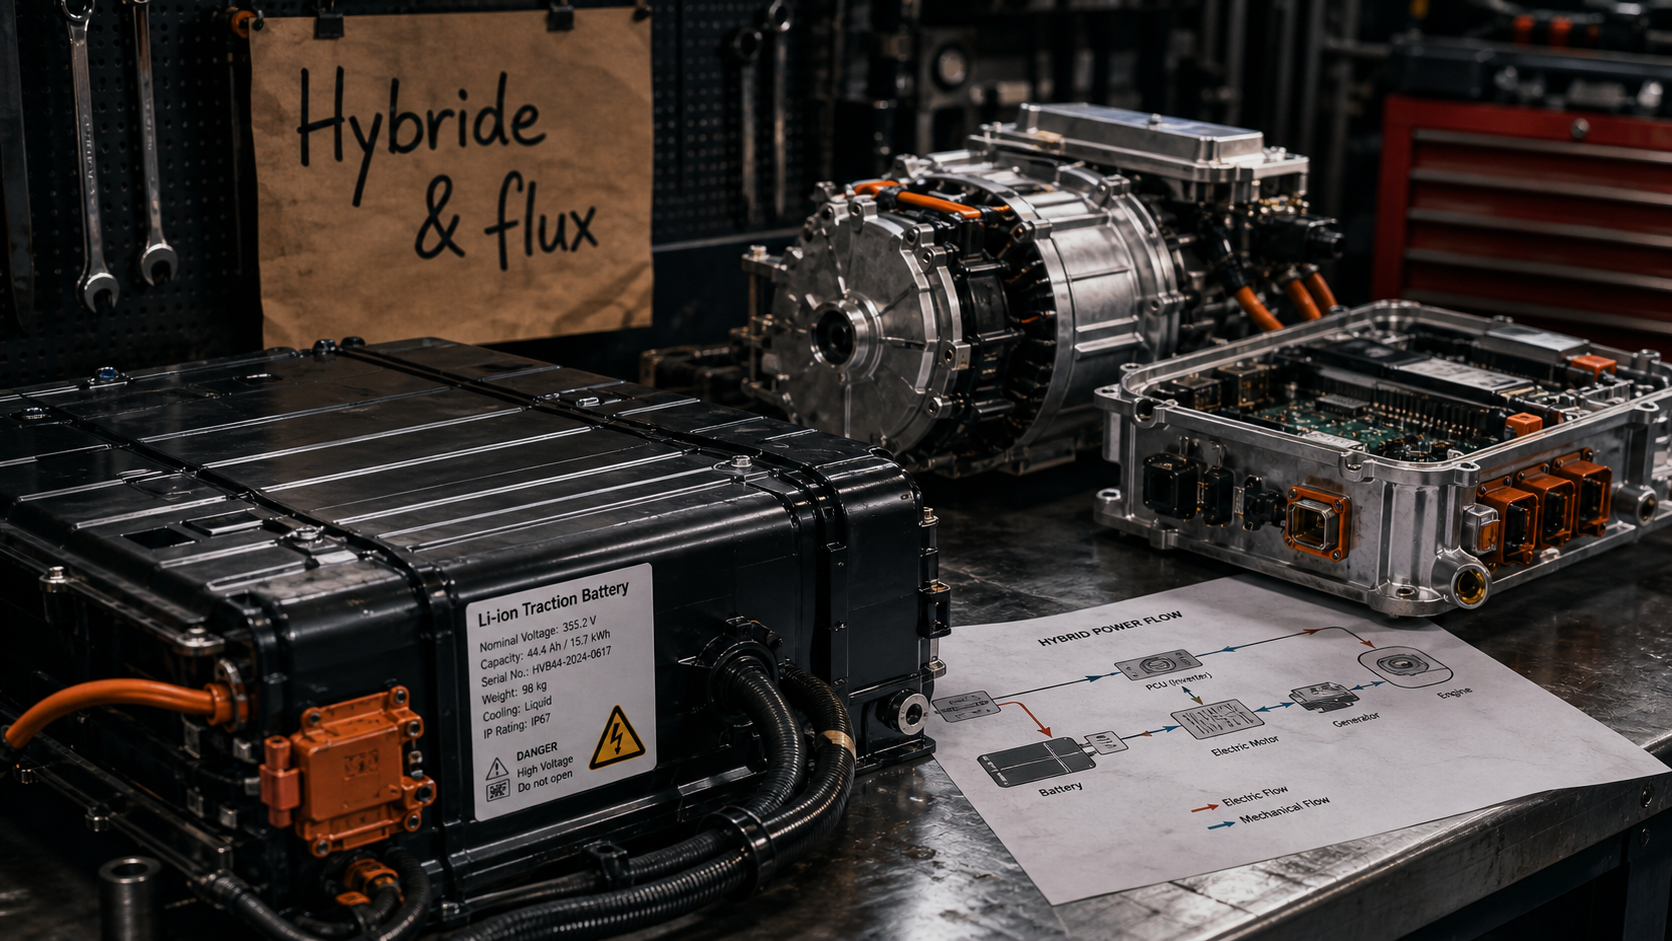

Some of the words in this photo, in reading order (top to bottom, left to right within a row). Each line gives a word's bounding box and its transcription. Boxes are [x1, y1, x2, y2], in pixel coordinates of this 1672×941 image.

[296, 65, 547, 207] Hybride
[415, 174, 465, 259] &
[484, 170, 598, 271] flux
[478, 608, 518, 627] Li-ion
[522, 594, 577, 616] Traction
[582, 582, 629, 602] Battery
[480, 635, 518, 652] Nominal
[521, 626, 559, 643] Voltage:
[563, 617, 588, 632] 355.2
[590, 615, 597, 625] V
[1038, 631, 1090, 646] HYBRID
[1092, 619, 1143, 636] POWER
[1143, 611, 1182, 624] FLOW
[480, 652, 523, 670] Capacity:
[527, 645, 547, 658] 44.4
[549, 641, 561, 653] Ah
[570, 634, 588, 647] 15.7
[591, 629, 611, 642] kWh
[481, 672, 507, 687] Serial
[510, 668, 529, 680] No.:
[532, 645, 612, 675] HVB44-2024-0617
[482, 689, 518, 705] Weight:
[522, 684, 533, 694] 98
[536, 681, 547, 693] kg
[1145, 682, 1168, 691] PCU
[1437, 687, 1472, 699] Engine
[483, 705, 521, 722] Cooling:
[524, 695, 552, 712] Liquid
[1333, 712, 1381, 728] Generator
[483, 728, 493, 739] IP
[496, 720, 528, 736] Rating:
[531, 713, 551, 727] IP67
[517, 741, 558, 761] DANGER
[1211, 741, 1250, 757] Electric
[1249, 735, 1280, 748] Motor
[517, 764, 538, 778] High
[540, 755, 574, 771] Voltage
[518, 780, 531, 793] Do
[533, 778, 549, 789] not
[551, 770, 573, 784] open
[1039, 782, 1082, 796] Battery
[1222, 792, 1264, 807] Electric
[1262, 785, 1289, 797] Flow
[1239, 803, 1302, 824] Mechanical
[1302, 796, 1331, 808] Flow
